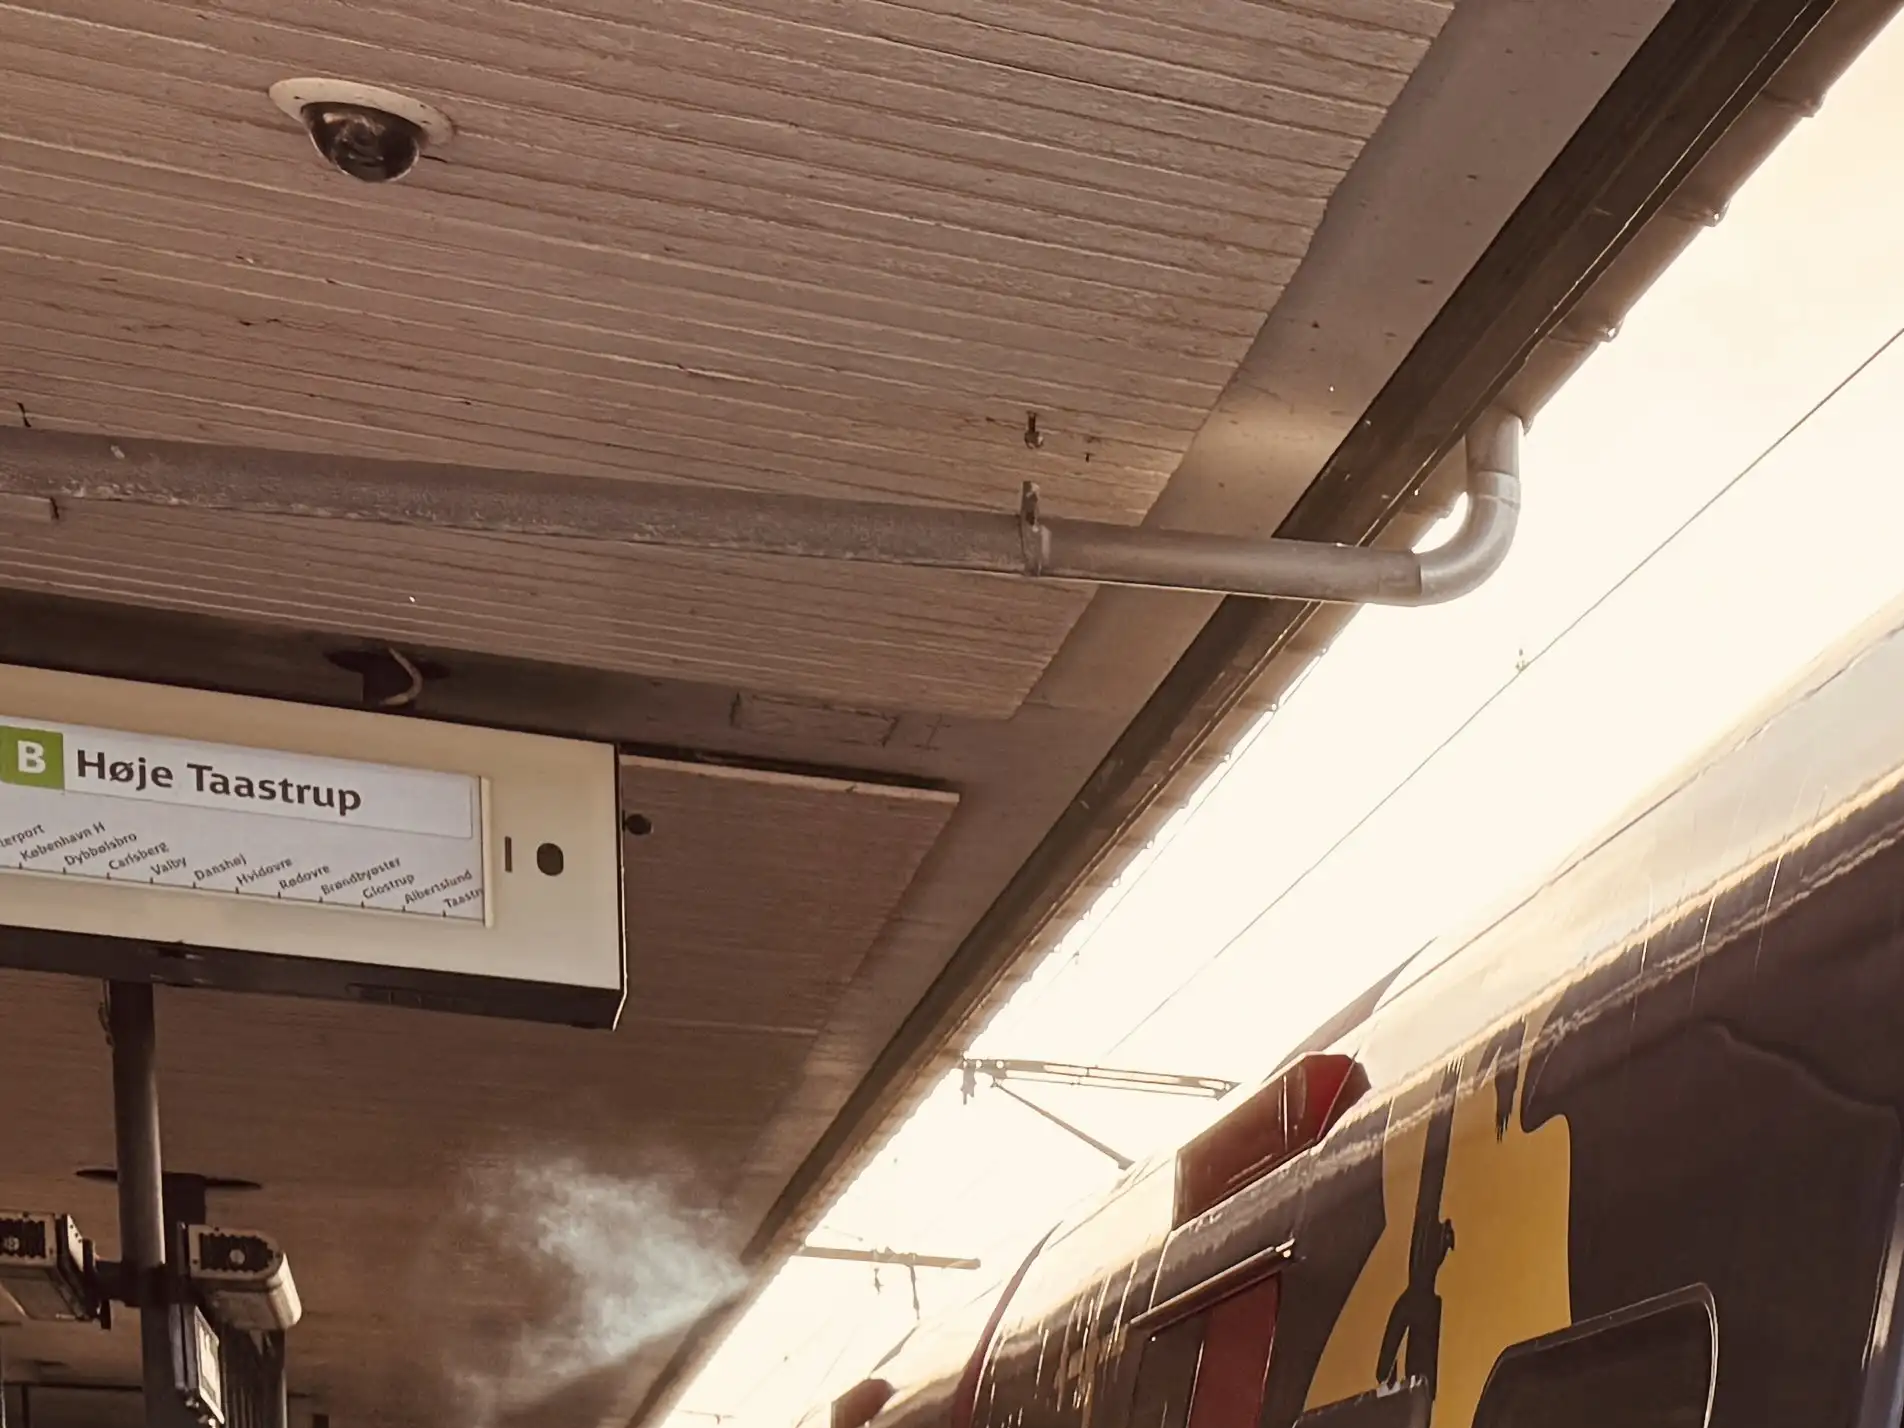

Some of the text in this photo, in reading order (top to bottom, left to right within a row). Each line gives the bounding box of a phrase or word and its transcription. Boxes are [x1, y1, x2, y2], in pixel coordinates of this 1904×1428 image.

[17, 740, 46, 774] B
[77, 749, 362, 816] Høje Taastrup
[20, 821, 106, 862] København H
[64, 832, 138, 866] Dybbølsbro
[108, 841, 170, 871] Carlsberg
[151, 856, 187, 877] Valby
[193, 853, 248, 881] Danshøj
[236, 858, 293, 886] Hvidovre
[278, 865, 330, 890] Rødovre
[321, 858, 401, 896] Brøndbyøster
[362, 874, 415, 899] Glostrup
[404, 869, 473, 905] Albertslund
